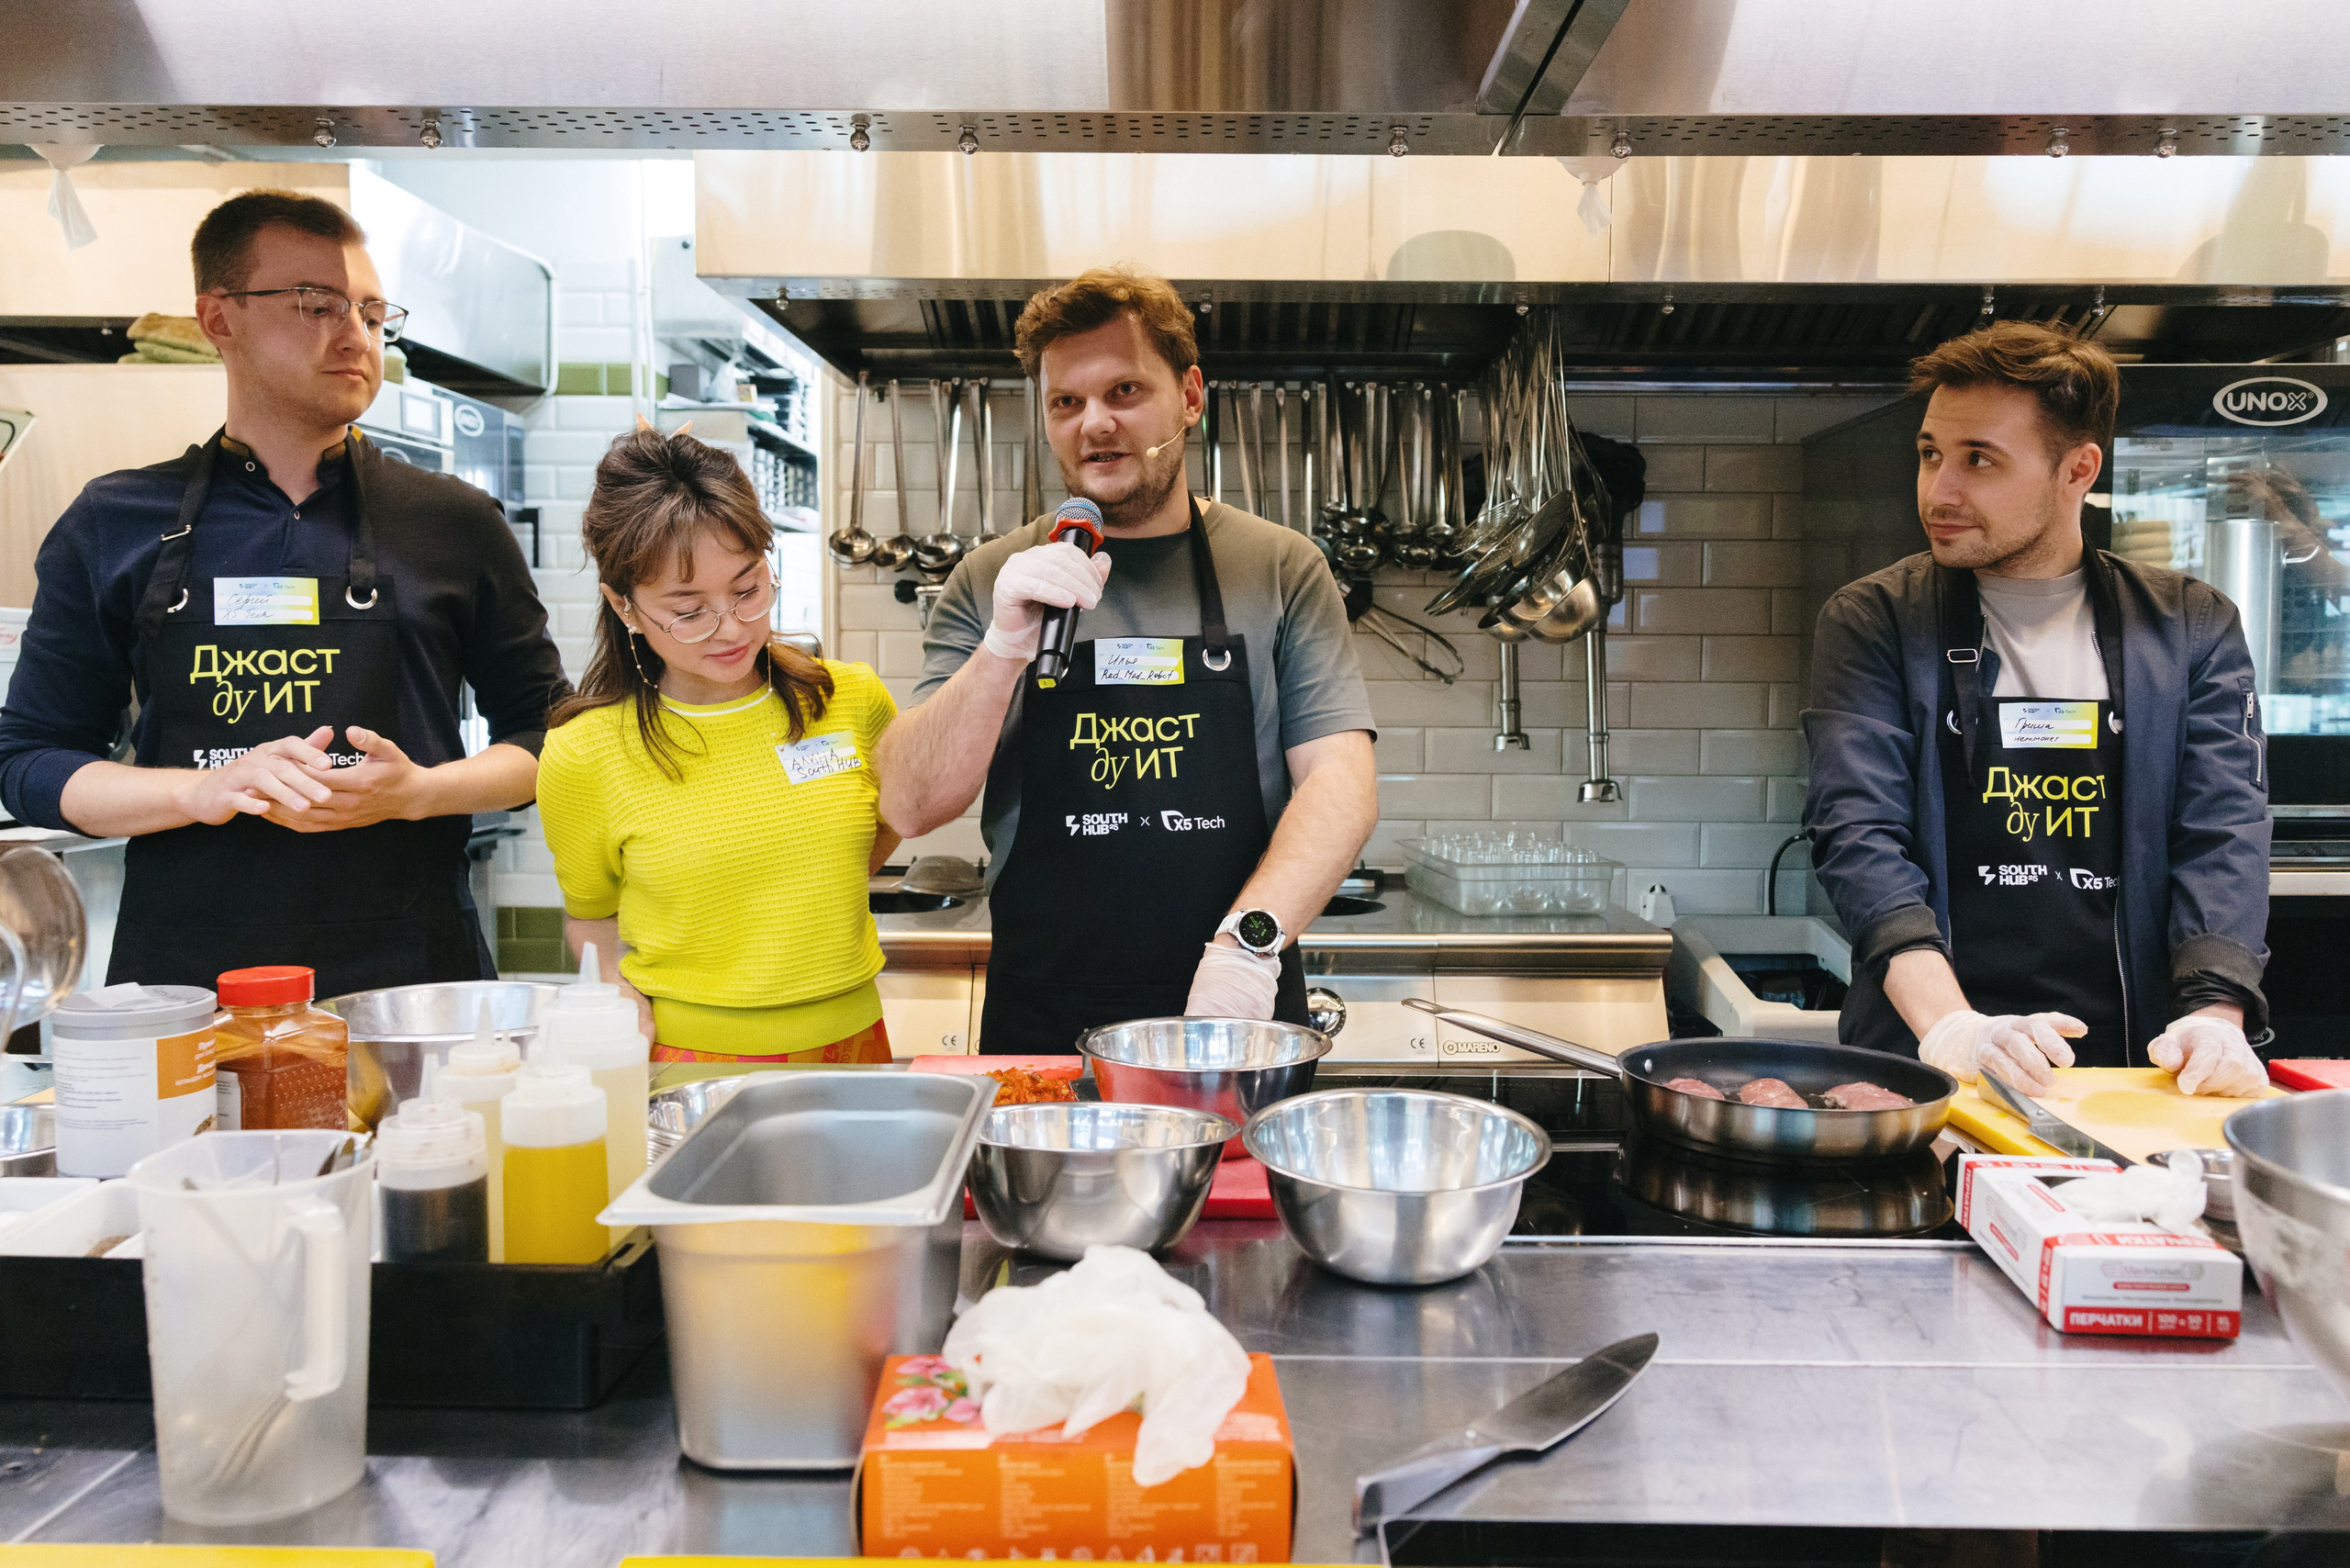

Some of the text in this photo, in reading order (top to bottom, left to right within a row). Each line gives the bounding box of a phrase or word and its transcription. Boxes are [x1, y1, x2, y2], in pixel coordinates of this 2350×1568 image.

[2227, 392, 2307, 411] UNOX
[190, 644, 341, 685] Джаст
[212, 680, 320, 724] ду ИТ
[1069, 712, 1201, 750] Джаст
[2015, 718, 2054, 734] Гриша
[1091, 745, 1183, 790] ду ИТ
[1982, 767, 2106, 803] Джаст
[1082, 812, 1128, 825] SOUTH
[1194, 816, 1225, 830] Tech
[2006, 801, 2099, 843] ду ИТ
[1998, 865, 2048, 876] SOUTH
[2104, 876, 2120, 889] Tec
[1458, 1042, 1500, 1053] MARENO
[2070, 1313, 2143, 1327] ПЕРЧАТКИ
